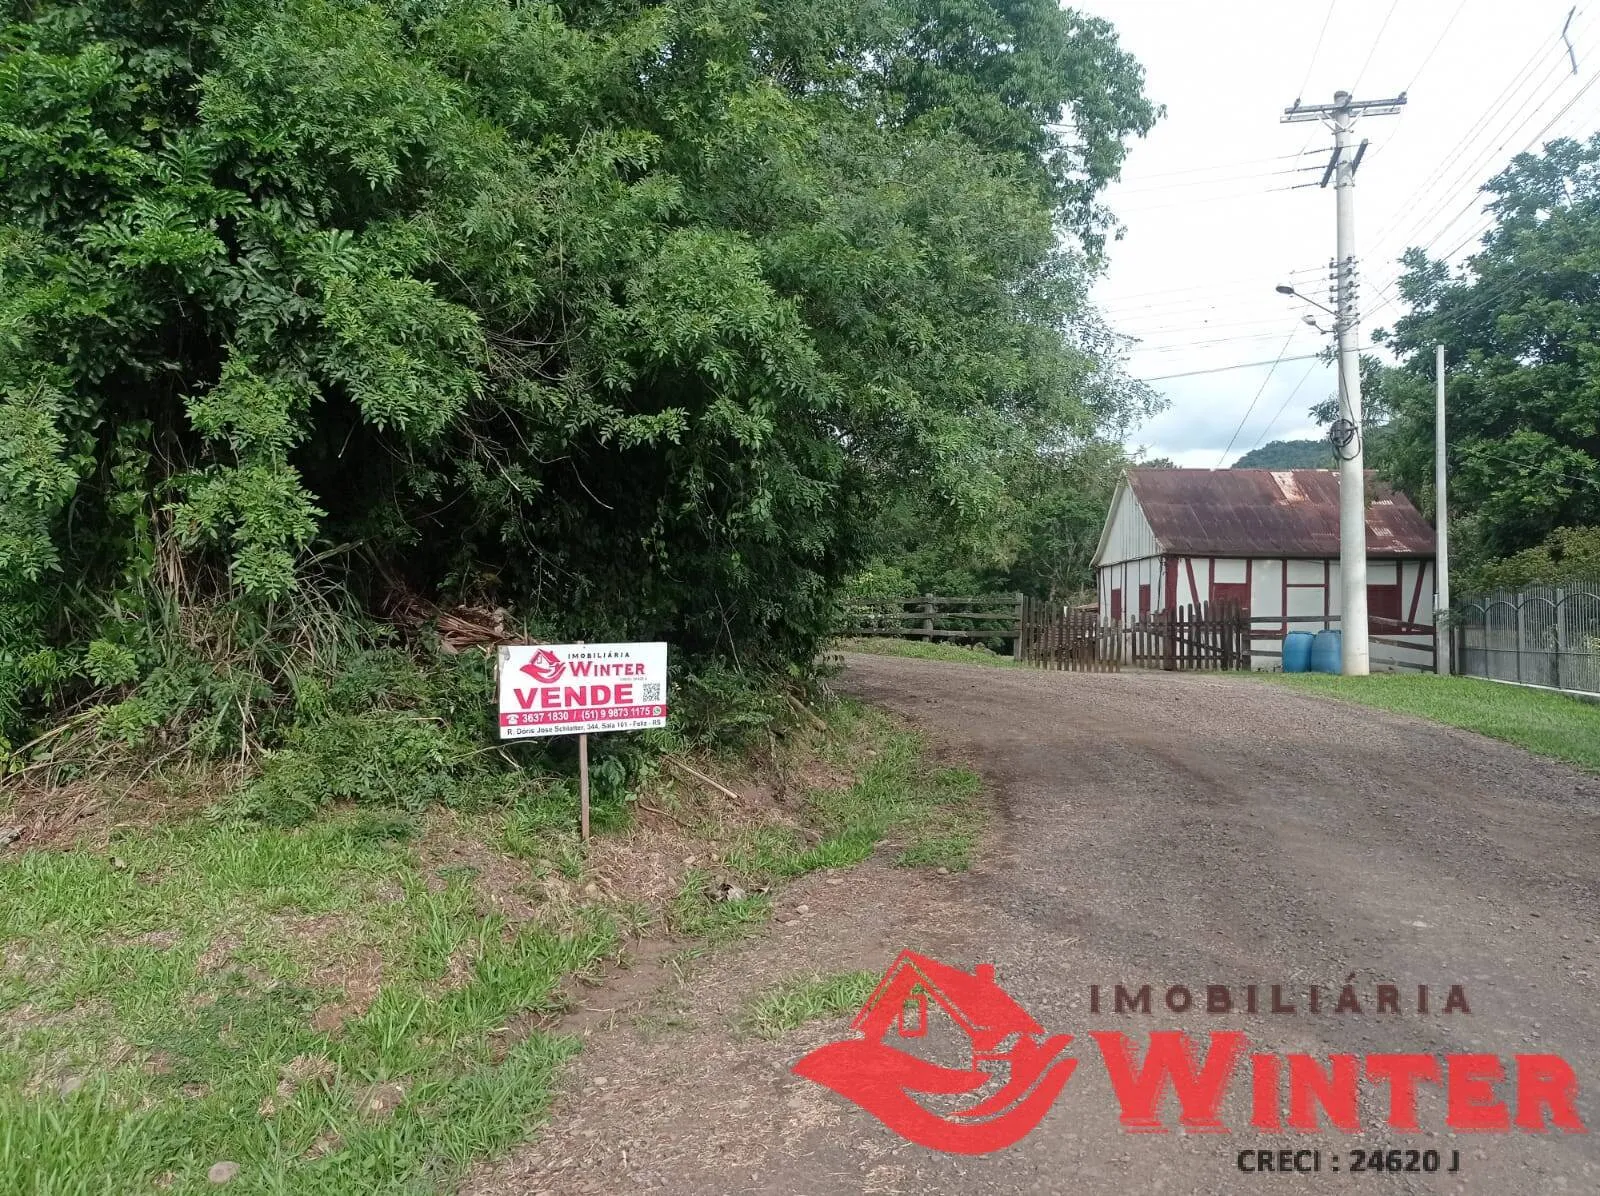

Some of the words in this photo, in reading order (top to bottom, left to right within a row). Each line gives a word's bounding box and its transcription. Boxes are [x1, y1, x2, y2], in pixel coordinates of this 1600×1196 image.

[568, 651, 630, 660] IMOBILIÁRIA
[568, 660, 645, 677] WINTER
[513, 683, 634, 710] VENDE
[522, 712, 545, 723] 3637
[547, 711, 569, 721] 1830
[581, 710, 599, 721] (51)
[600, 709, 606, 718] 9
[608, 707, 629, 718] 9873
[630, 706, 650, 716] 1175
